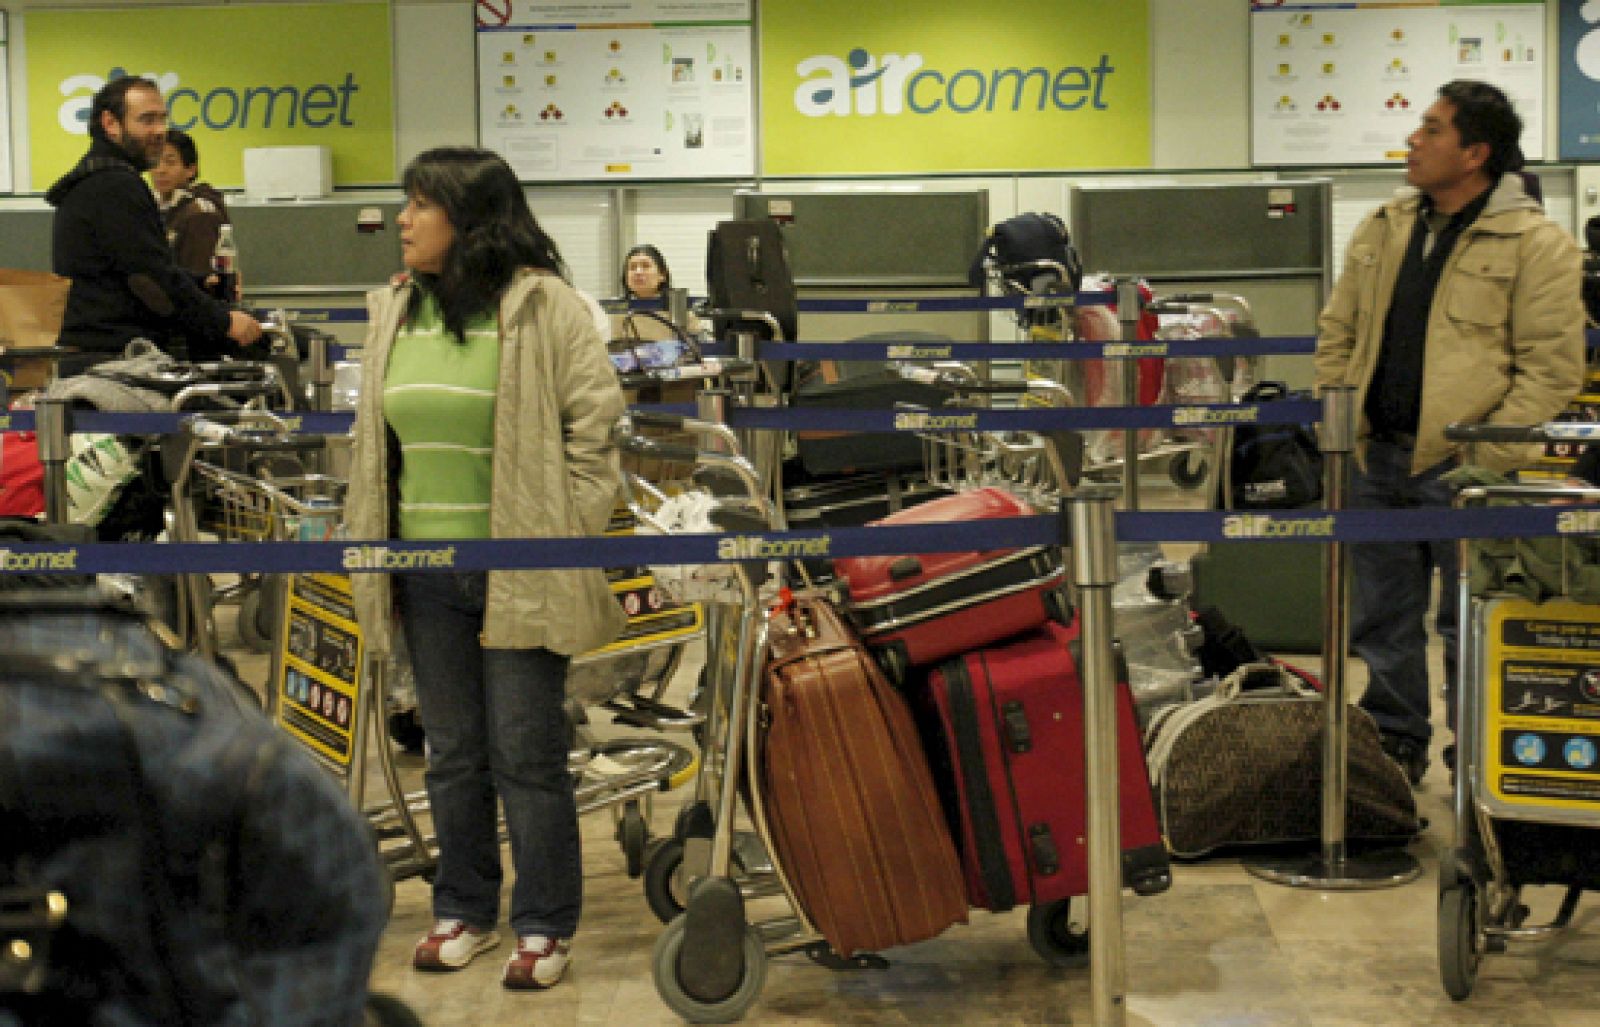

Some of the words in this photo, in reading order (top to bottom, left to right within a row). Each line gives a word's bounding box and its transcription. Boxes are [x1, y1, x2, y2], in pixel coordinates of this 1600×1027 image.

[794, 47, 1114, 117] aircomet
[1222, 512, 1336, 538] aircomet
[342, 544, 457, 569] aircomet
[717, 534, 832, 560] aircomet
